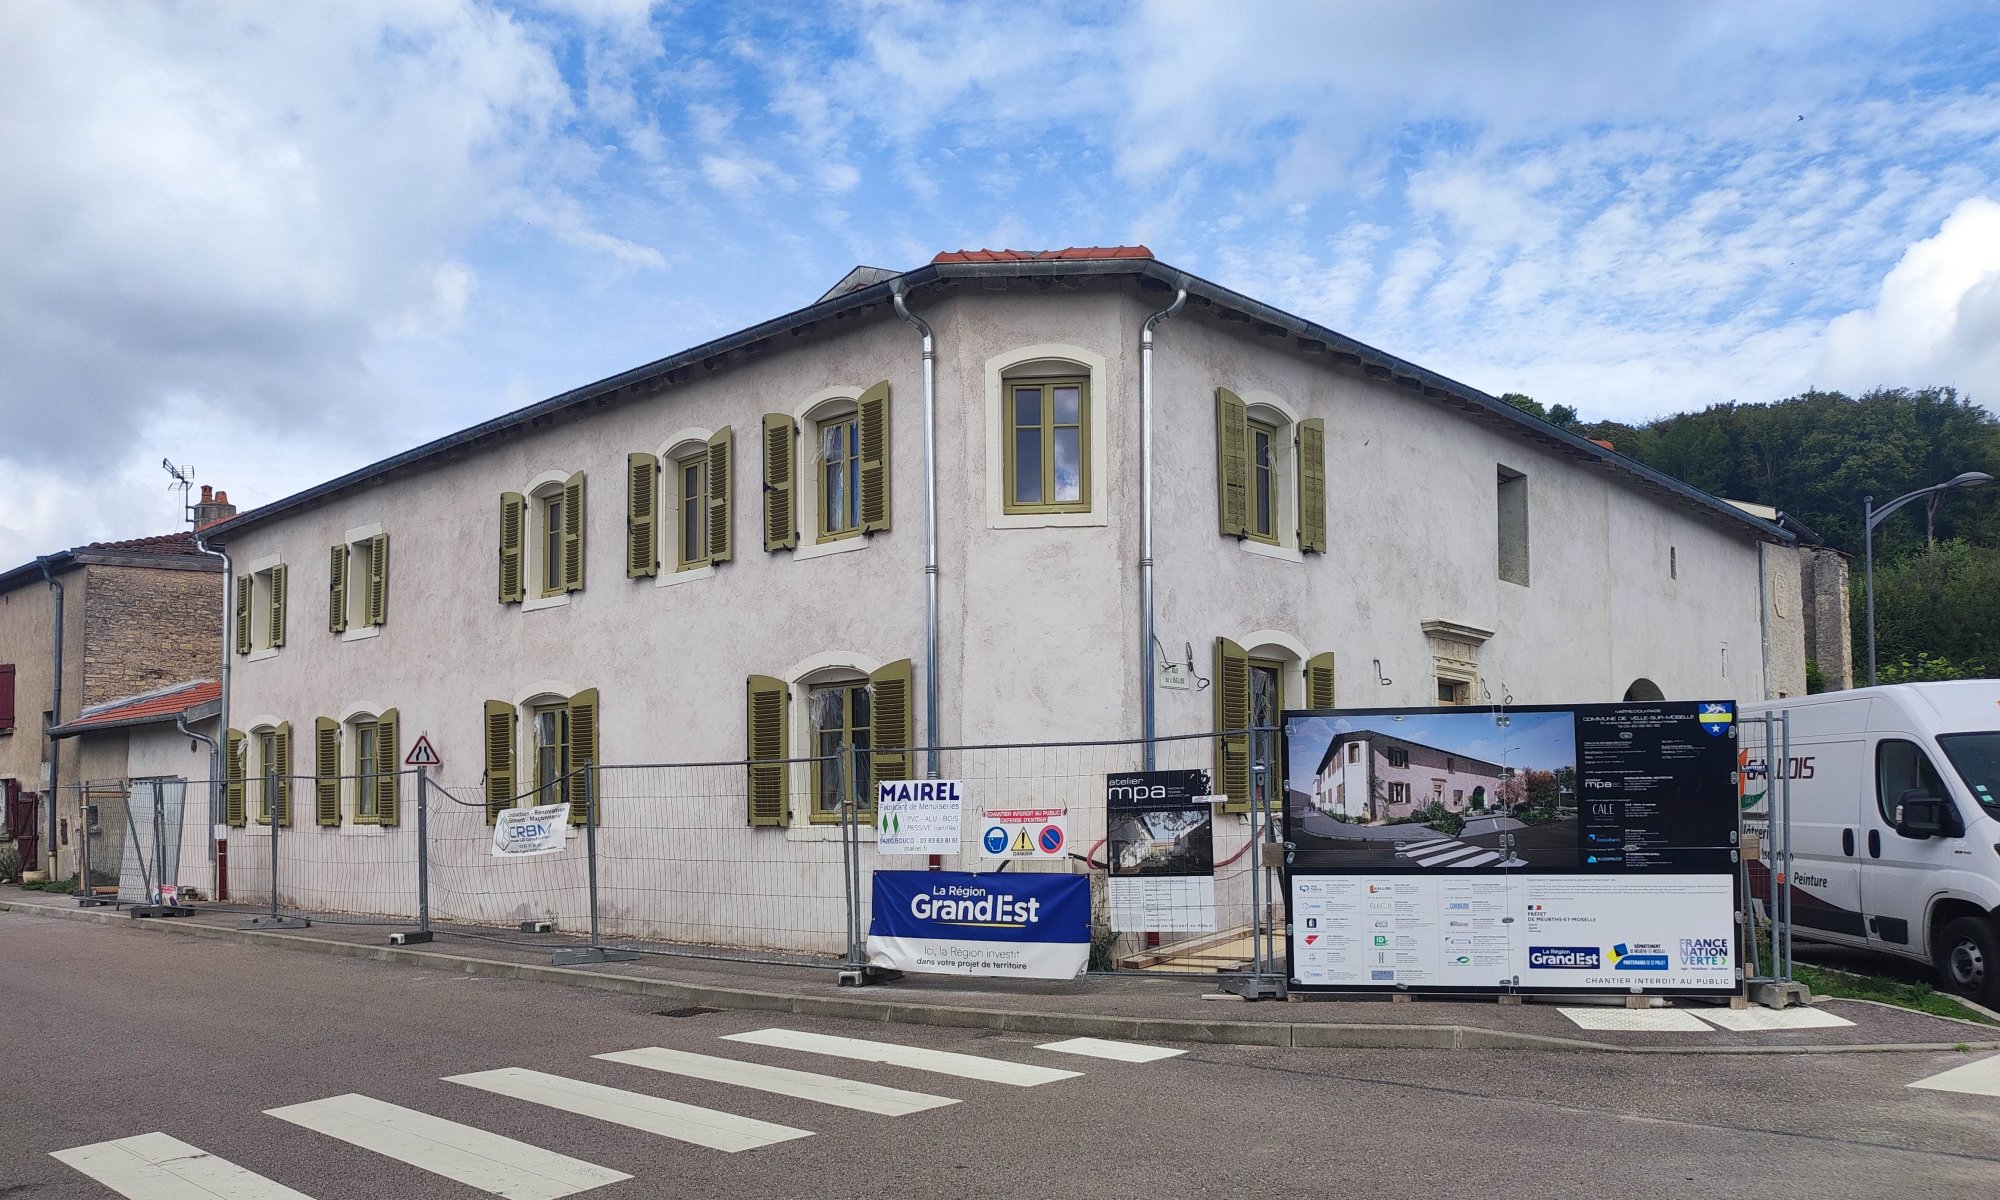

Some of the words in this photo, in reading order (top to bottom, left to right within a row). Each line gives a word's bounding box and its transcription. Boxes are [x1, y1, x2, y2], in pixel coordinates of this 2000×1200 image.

[1109, 778, 1144, 786] atelier
[880, 782, 960, 802] MAIREL
[1108, 786, 1166, 802] mpa
[1592, 804, 1614, 815] CALE
[510, 823, 552, 838] CRBM
[1794, 872, 1828, 888] Peinture
[933, 886, 946, 895] La
[949, 886, 986, 898] Région
[1680, 939, 1727, 947] FRANCE
[924, 946, 937, 956] Ici,
[939, 946, 948, 956] la
[951, 946, 983, 960] Région
[986, 948, 1020, 958] investit
[1680, 948, 1728, 956] NATION
[958, 960, 979, 969] projet
[993, 962, 1027, 970] territoire
[1680, 957, 1718, 965] VERTE
